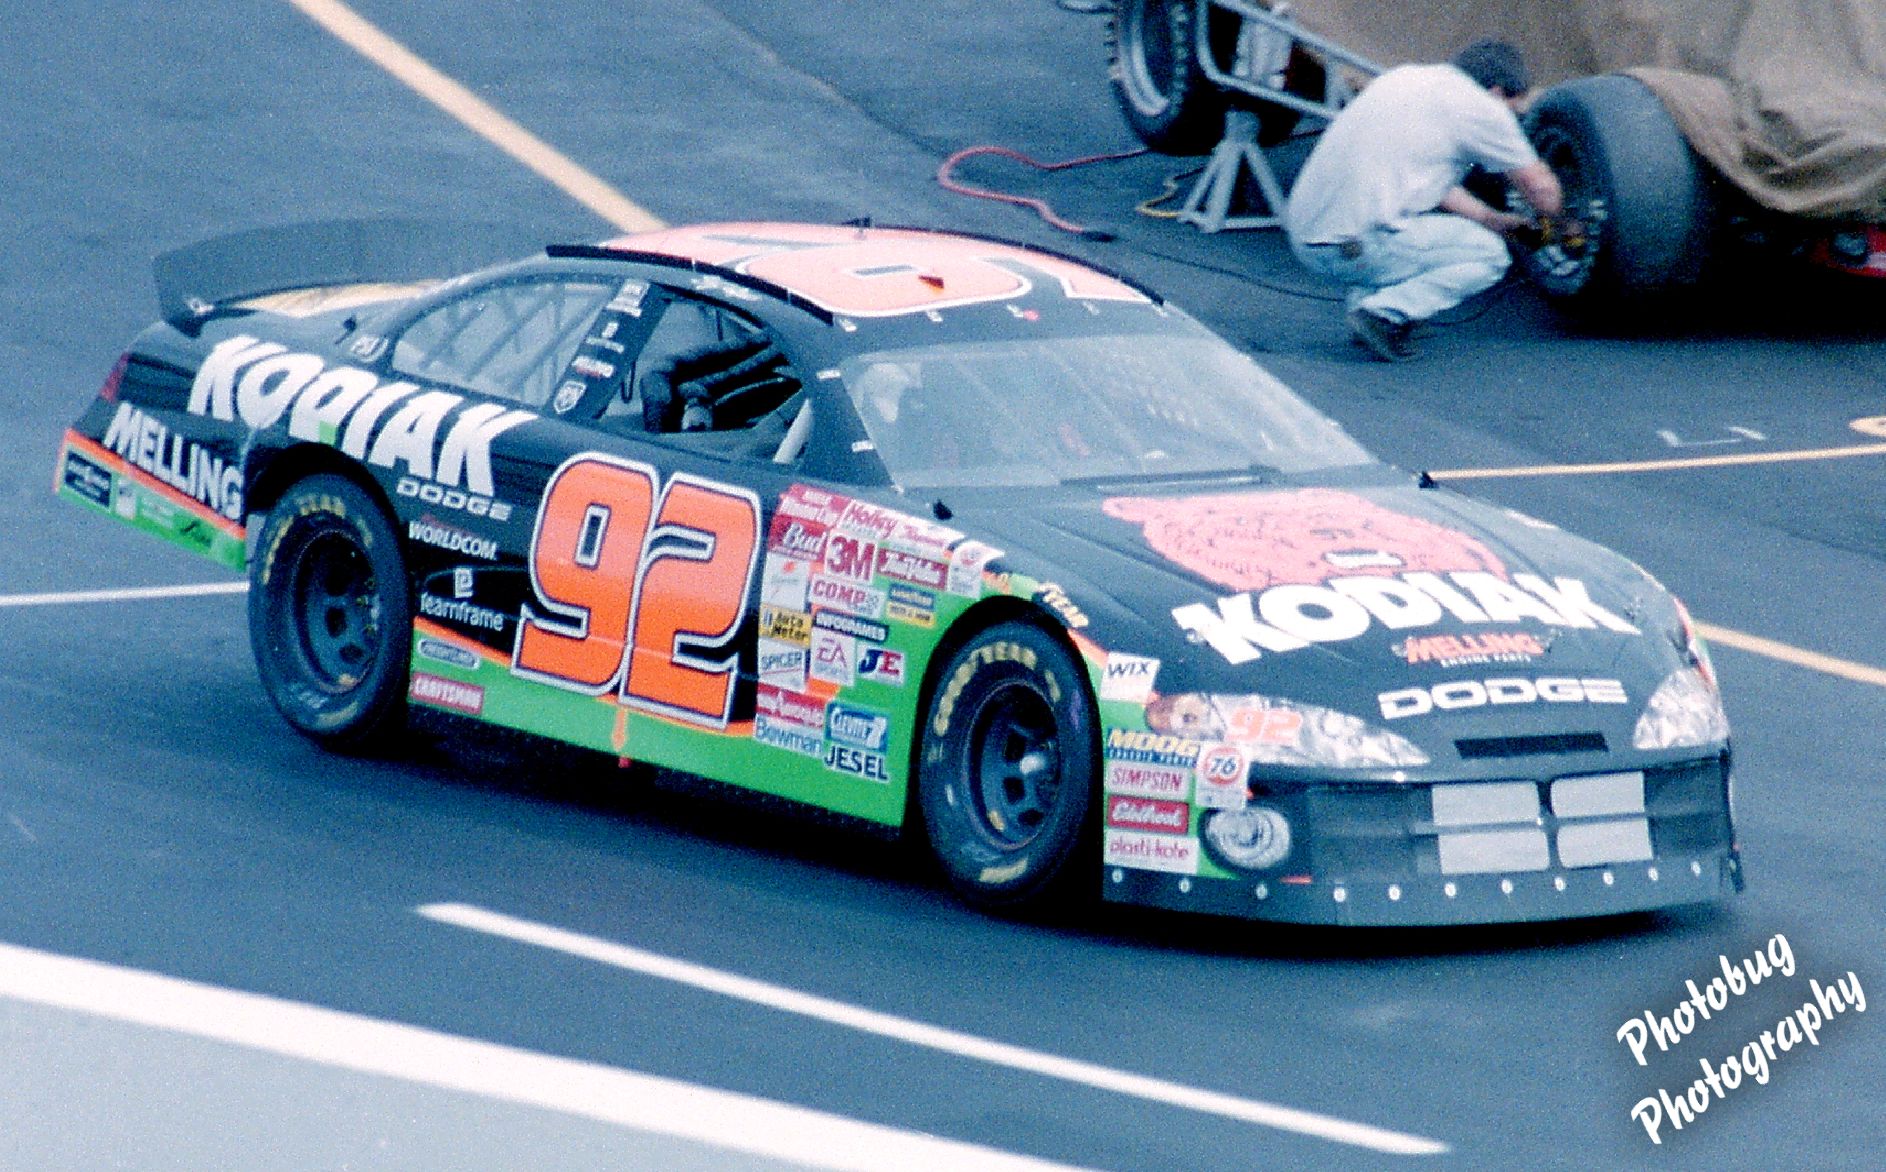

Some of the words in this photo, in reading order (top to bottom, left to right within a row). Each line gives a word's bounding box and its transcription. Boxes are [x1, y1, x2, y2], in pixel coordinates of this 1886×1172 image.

[187, 336, 539, 497] KODIAK
[103, 402, 242, 520] MELLING
[396, 478, 513, 521] DODGE
[783, 523, 827, 552] Bud
[830, 536, 876, 581] 3M
[509, 452, 761, 732] 92
[813, 580, 866, 604] COMP
[770, 625, 808, 641] Meter
[775, 611, 804, 628] Auto
[1172, 571, 1641, 664] KODIAK
[761, 651, 802, 672] SPICER
[815, 637, 847, 668] EA
[858, 649, 902, 676] JE
[1405, 633, 1545, 664] MELLING
[1107, 661, 1150, 678] WIX
[1378, 678, 1628, 719] DODGE
[756, 713, 822, 753] Bowman
[1228, 705, 1304, 743] 92
[1109, 729, 1200, 757] MOOG
[824, 746, 888, 781] JESEL
[1209, 756, 1238, 775] 76
[1112, 767, 1183, 792] SIMPSON
